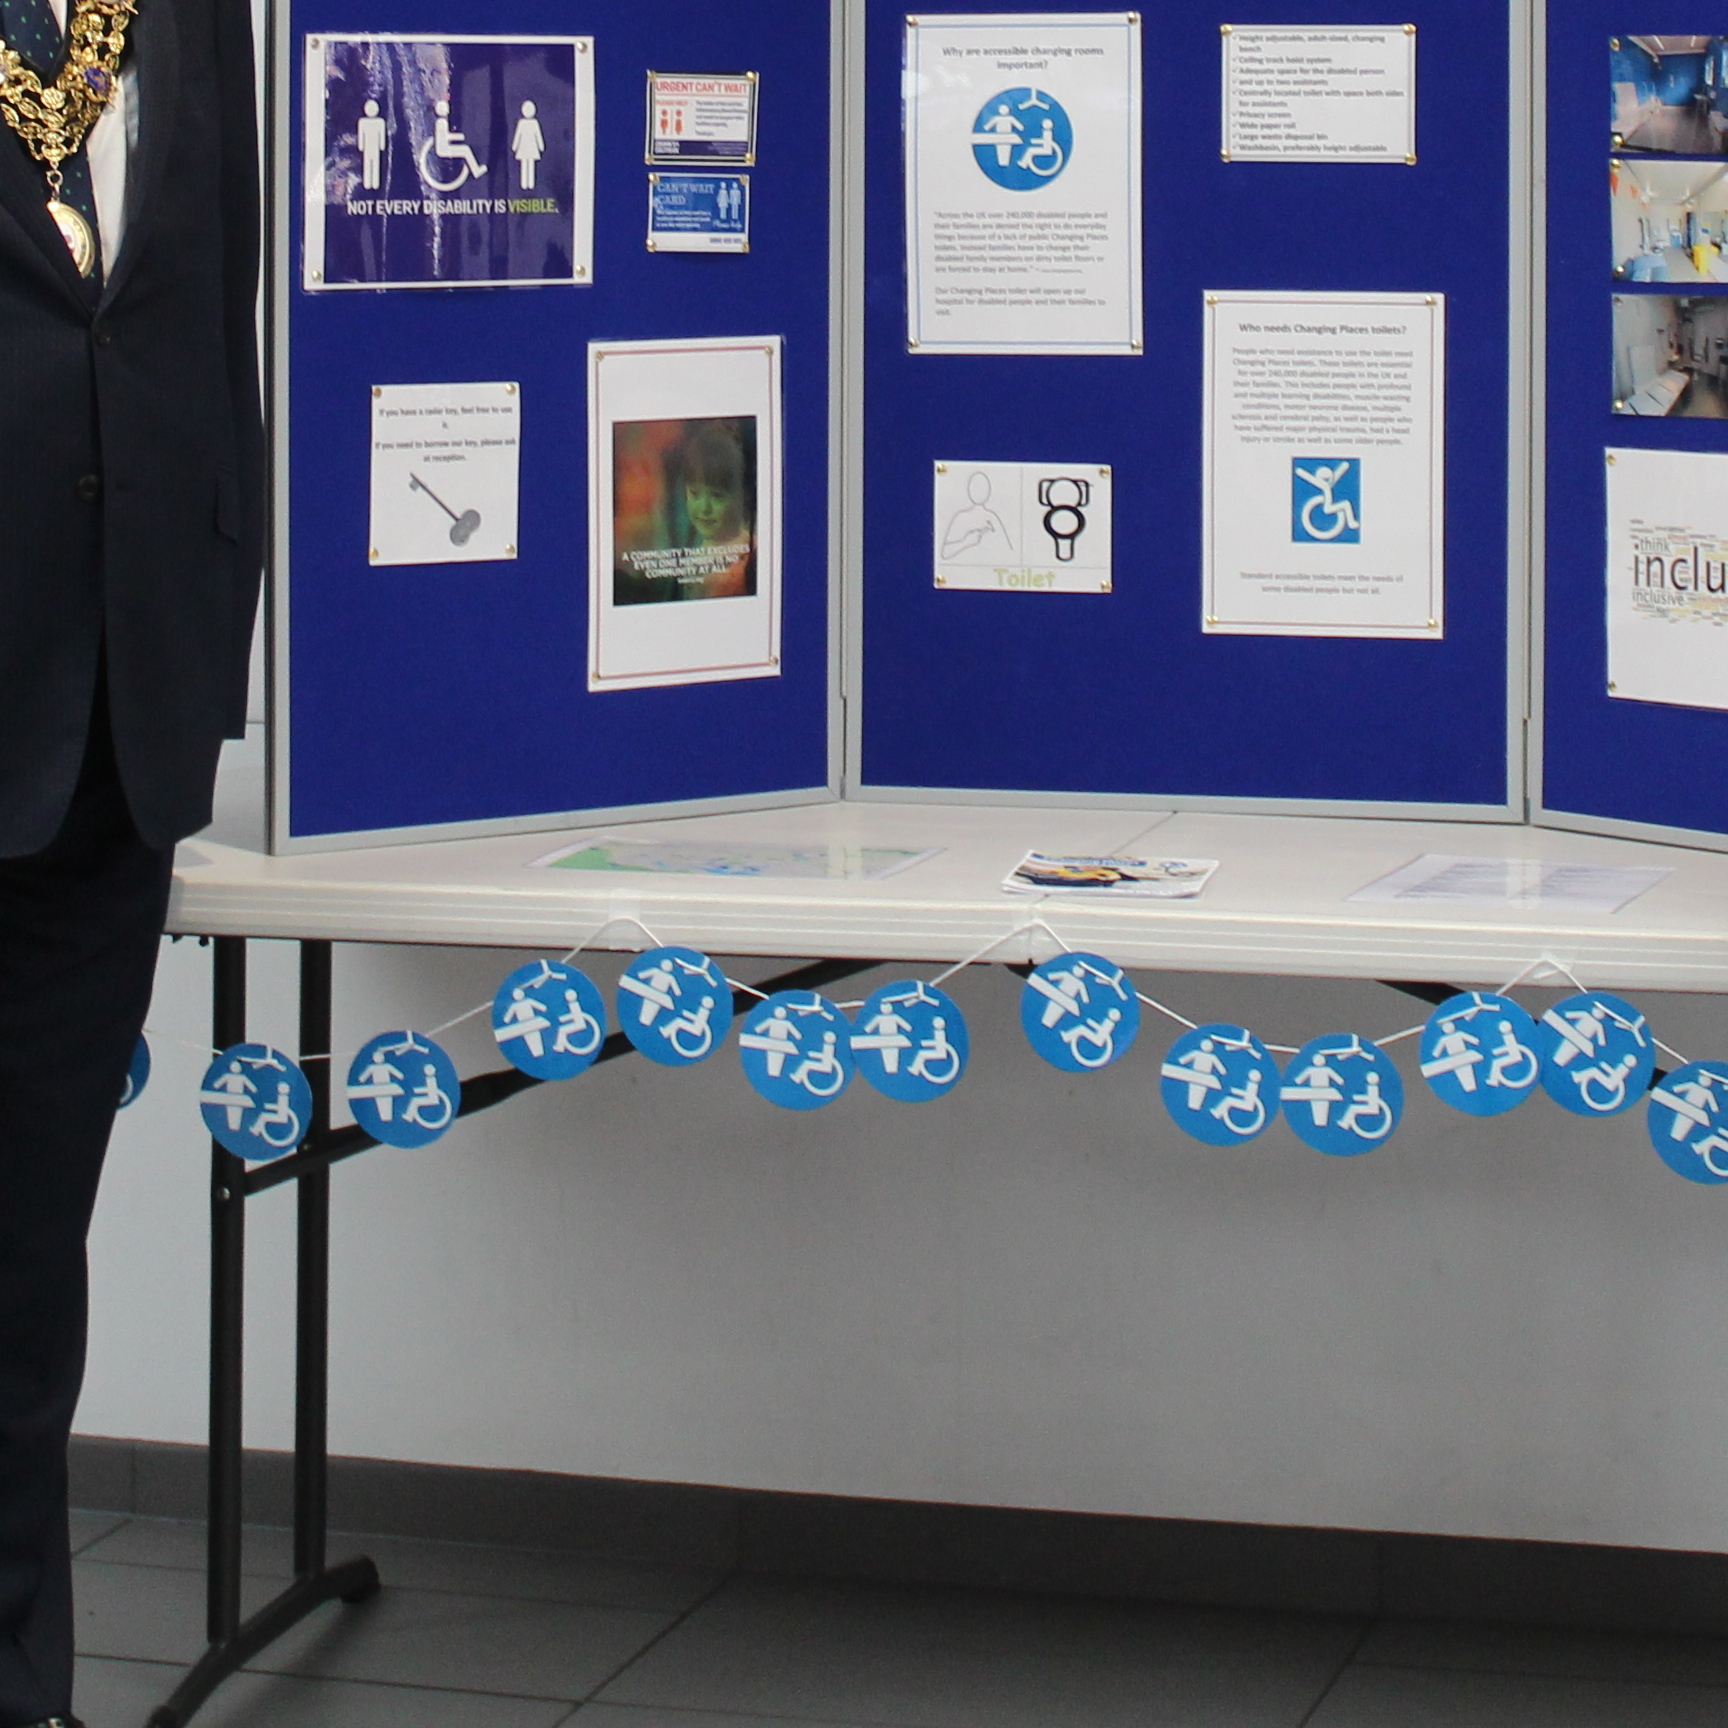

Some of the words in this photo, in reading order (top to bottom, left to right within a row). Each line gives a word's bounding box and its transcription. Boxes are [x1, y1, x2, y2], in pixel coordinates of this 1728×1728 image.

[656, 81, 694, 91] URGENT
[695, 81, 721, 92] CAN'T
[723, 83, 747, 93] WAIT
[347, 201, 374, 215] NOT
[377, 200, 421, 214] EVERY
[423, 199, 493, 214] DISABILITY
[494, 199, 506, 213] IS
[508, 199, 559, 214] VISIBLE.
[1239, 323, 1261, 332] Who
[1264, 324, 1292, 333] needs
[1293, 324, 1337, 335] Changing
[1339, 325, 1369, 333] Places
[1372, 325, 1407, 334] toilets?
[1639, 538, 1670, 553] think
[993, 568, 1056, 588] Toilet
[1633, 590, 1684, 605] inclusive
